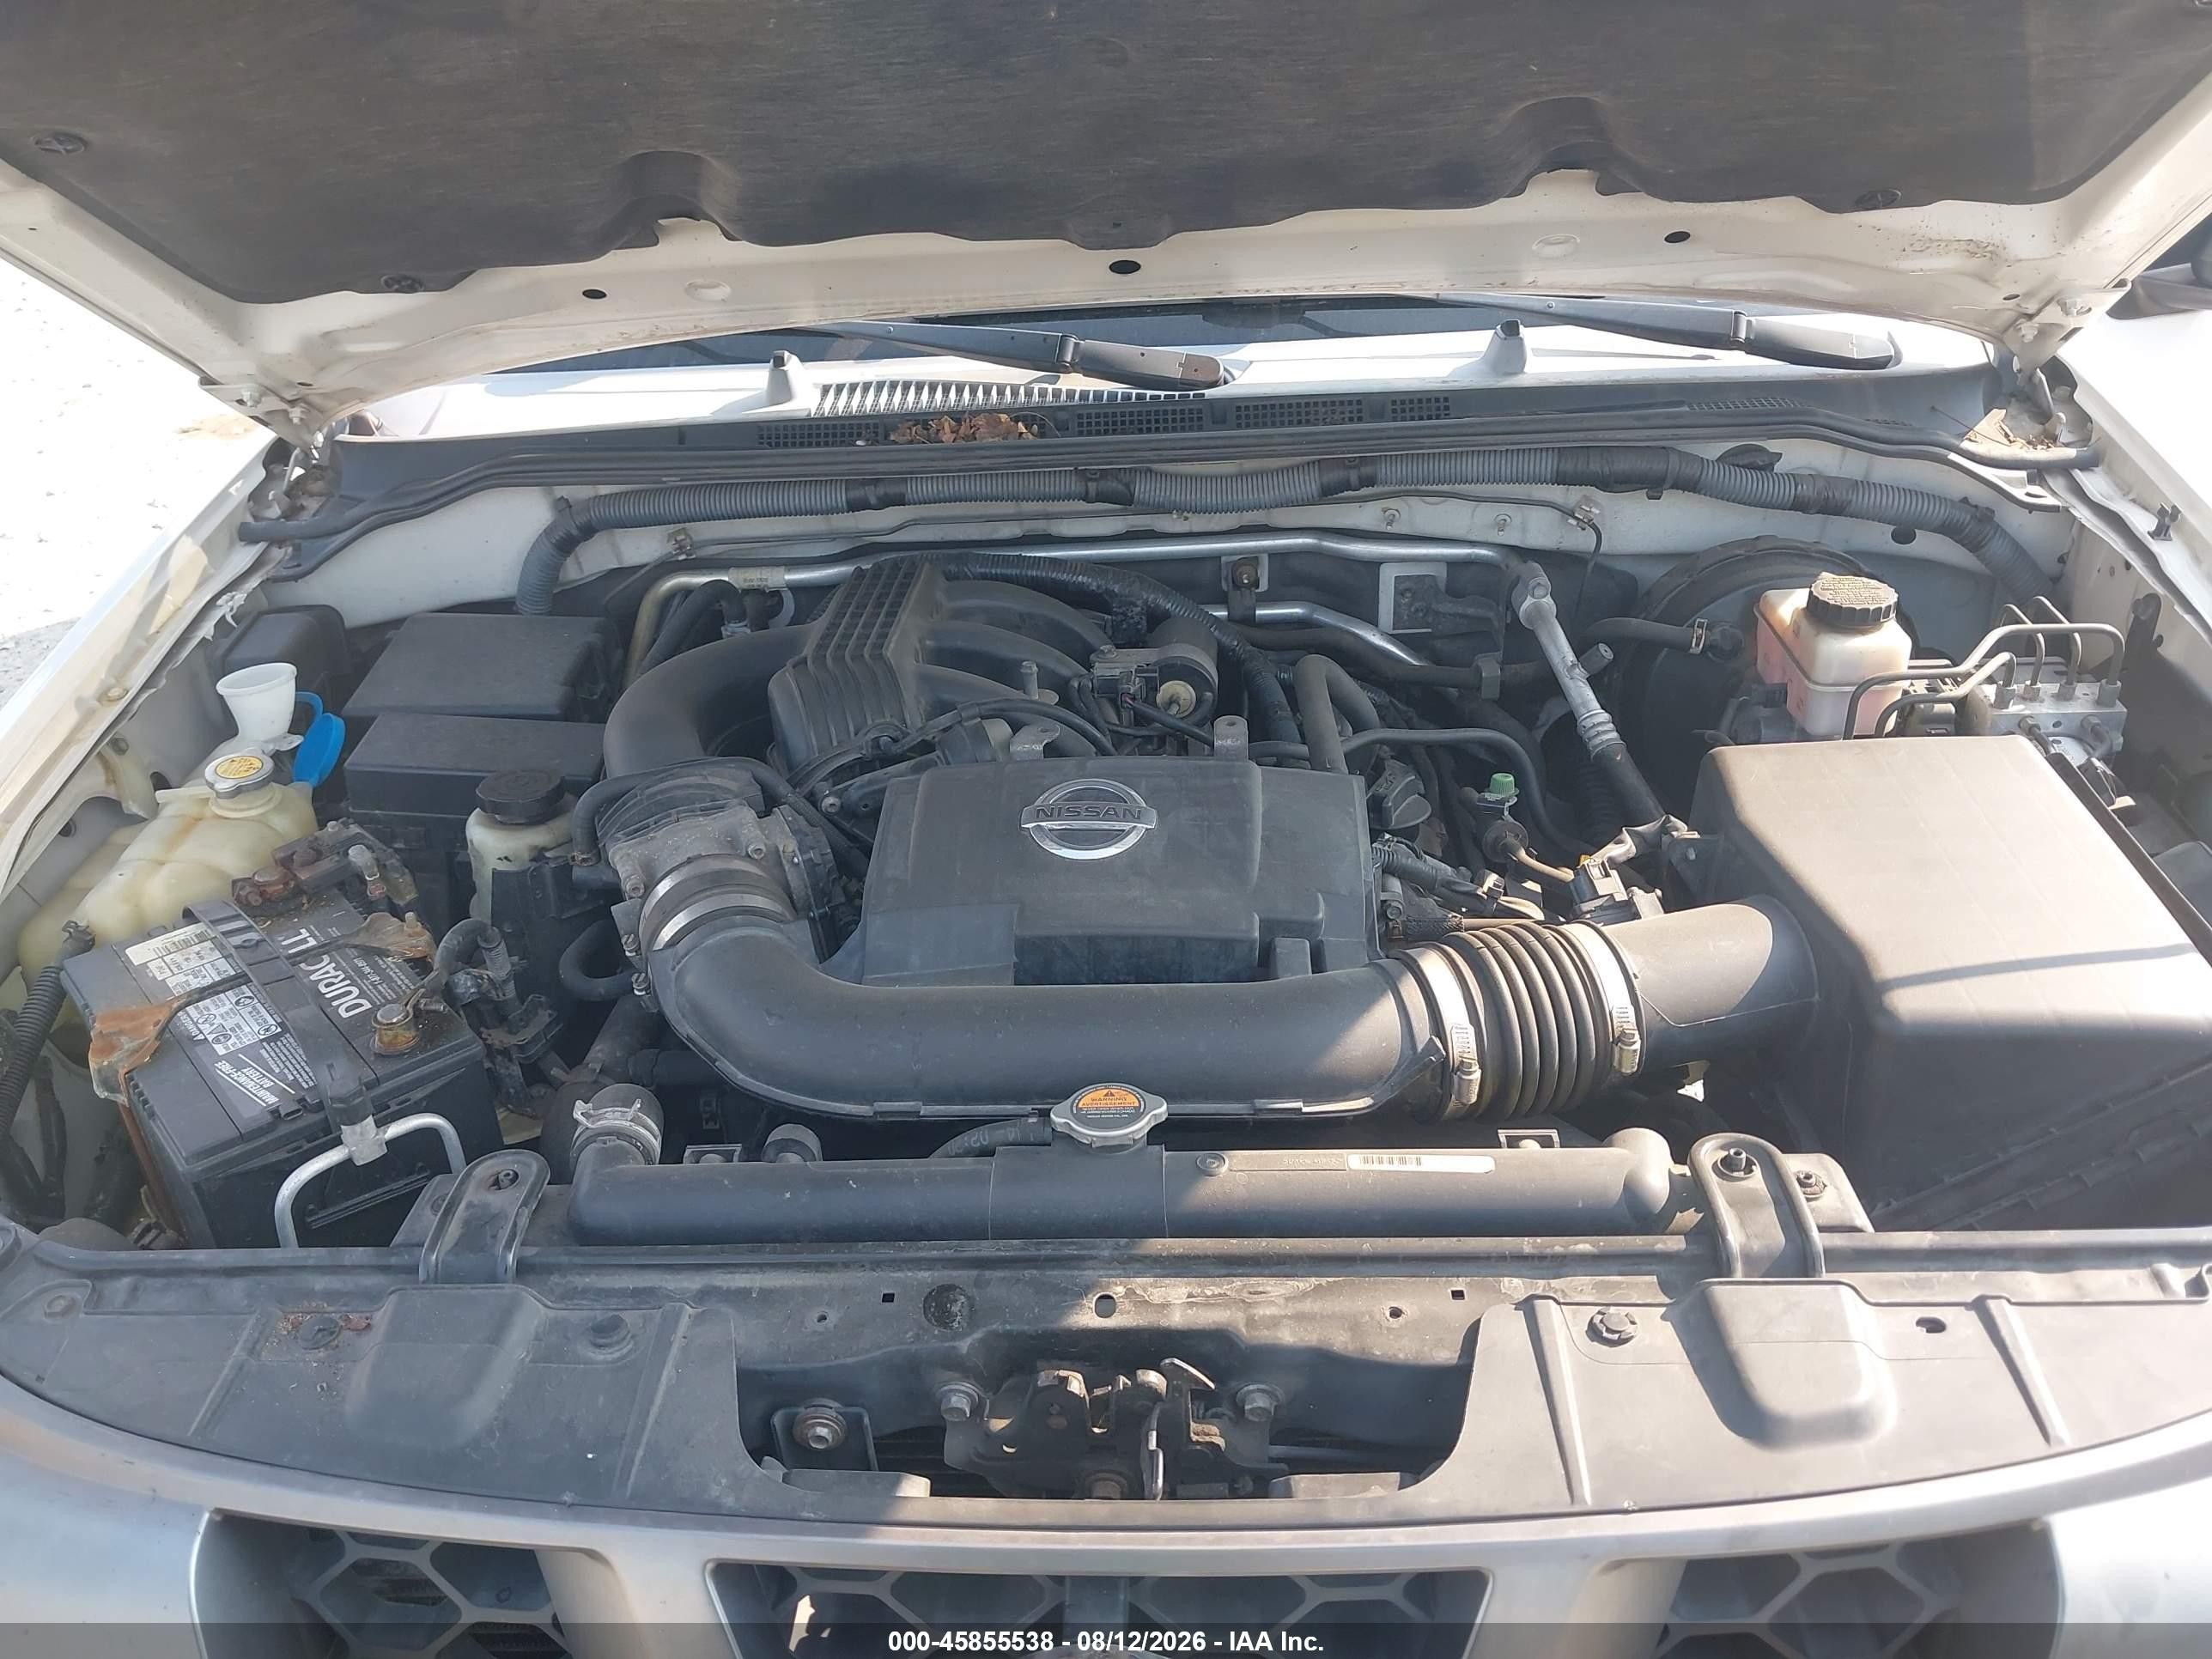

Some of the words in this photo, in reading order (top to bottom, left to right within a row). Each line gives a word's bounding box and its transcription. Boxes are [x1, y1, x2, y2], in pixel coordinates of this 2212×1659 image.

[1036, 805, 1141, 819] NISSAN
[278, 927, 374, 1018] DURACLL
[179, 1013, 200, 1036] DANGER
[214, 1060, 278, 1104] MAINTENANCE-FREE
[240, 1066, 274, 1088] BATTERY
